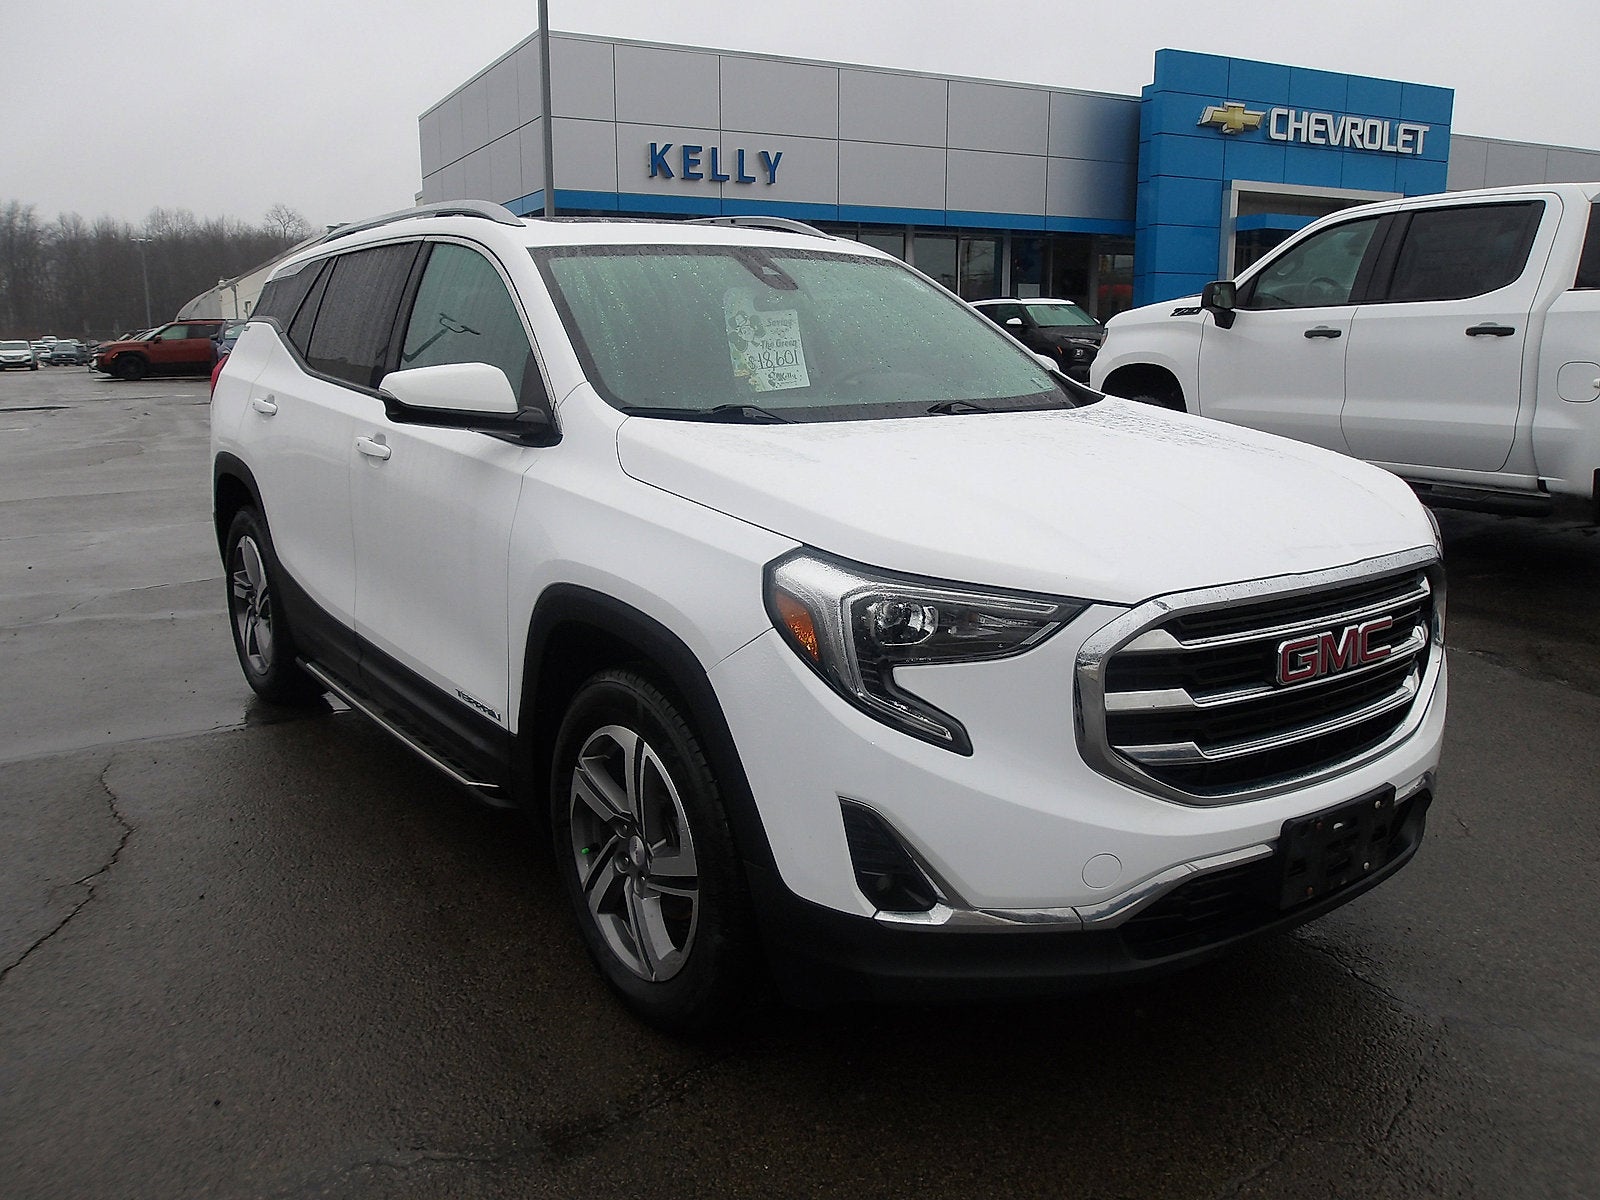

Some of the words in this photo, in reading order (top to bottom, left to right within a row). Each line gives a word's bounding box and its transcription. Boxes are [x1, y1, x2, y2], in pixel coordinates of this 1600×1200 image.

[1268, 106, 1430, 156] CHEVROLET
[648, 142, 783, 185] KELLY
[1277, 615, 1393, 685] GMC
